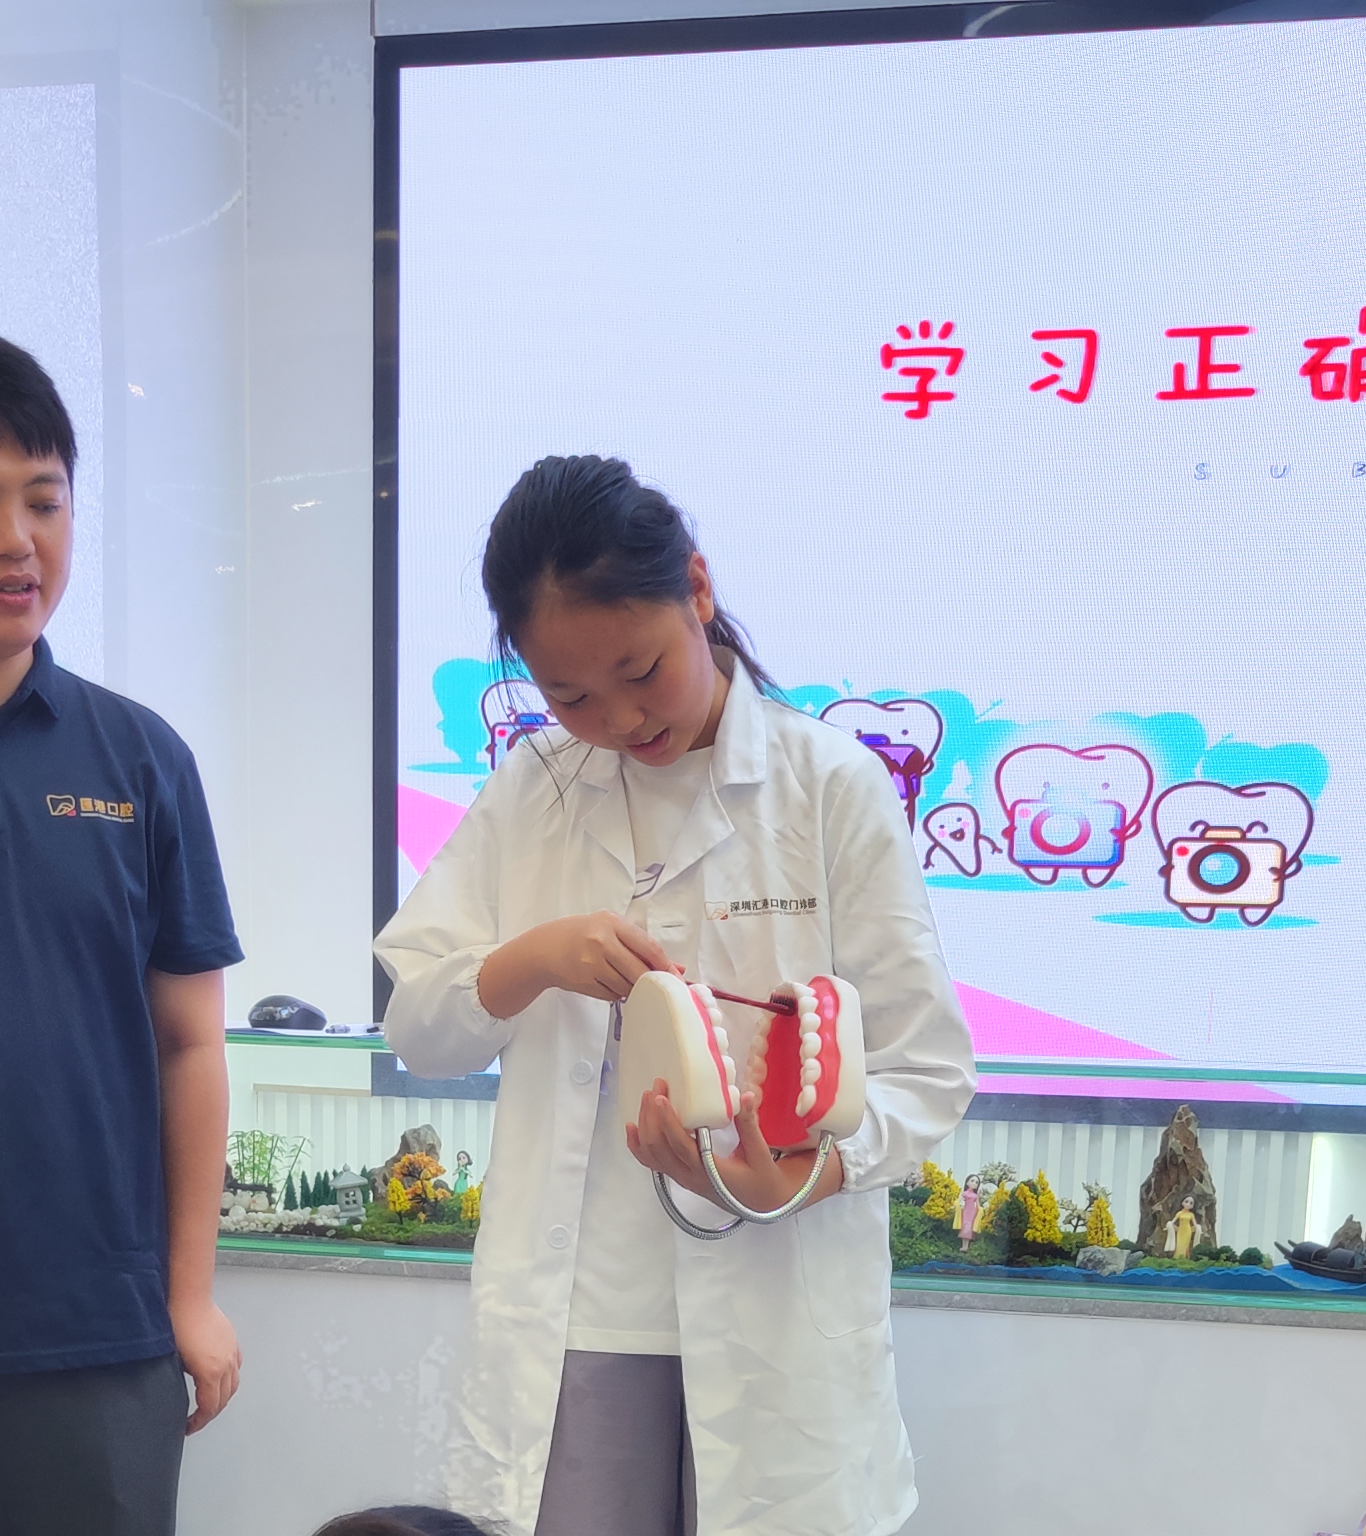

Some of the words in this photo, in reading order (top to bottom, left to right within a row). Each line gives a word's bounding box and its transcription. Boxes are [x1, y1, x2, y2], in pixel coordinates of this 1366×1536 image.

[730, 898, 817, 912] 深圳汇港口腔门诊部
